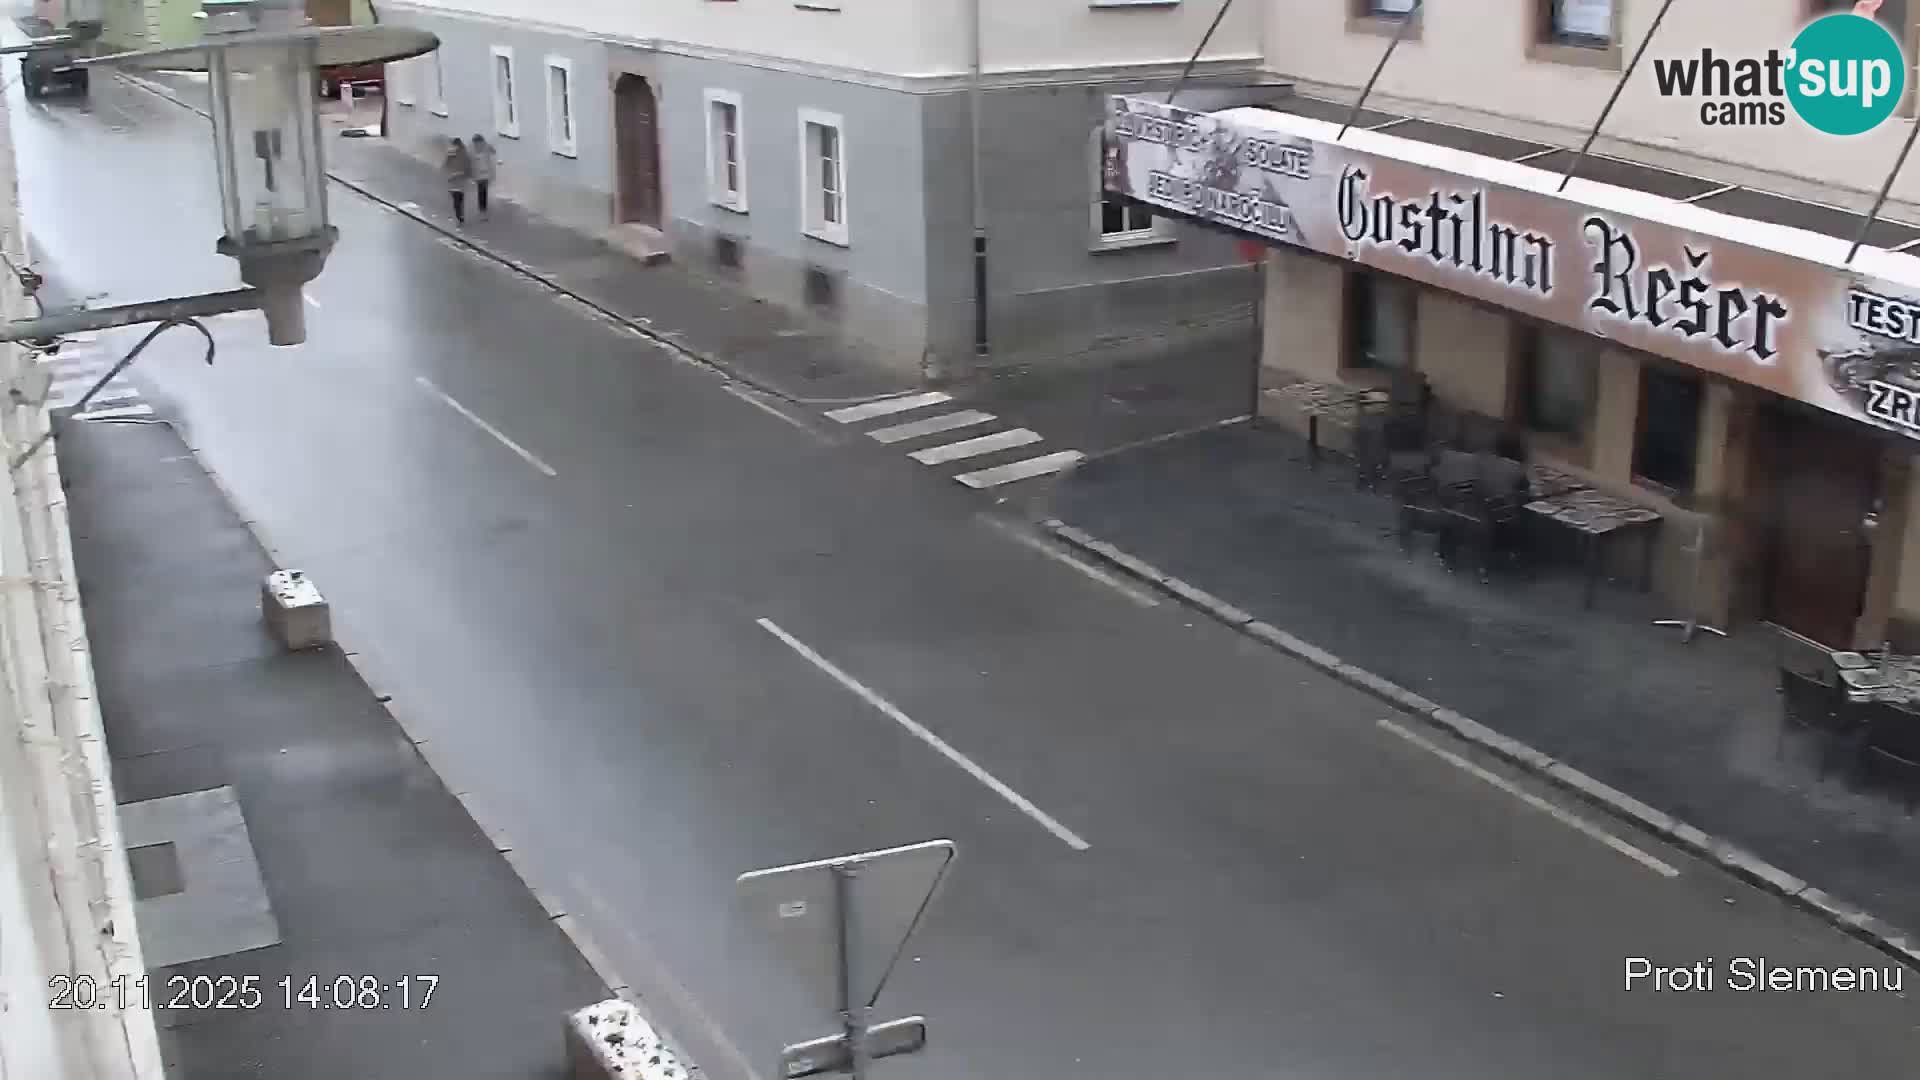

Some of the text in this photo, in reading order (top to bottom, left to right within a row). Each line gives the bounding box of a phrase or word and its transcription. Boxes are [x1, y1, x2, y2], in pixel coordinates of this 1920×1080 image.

[1246, 138, 1310, 179] SOLATE
[1337, 163, 1788, 360] Gostilna Rešer
